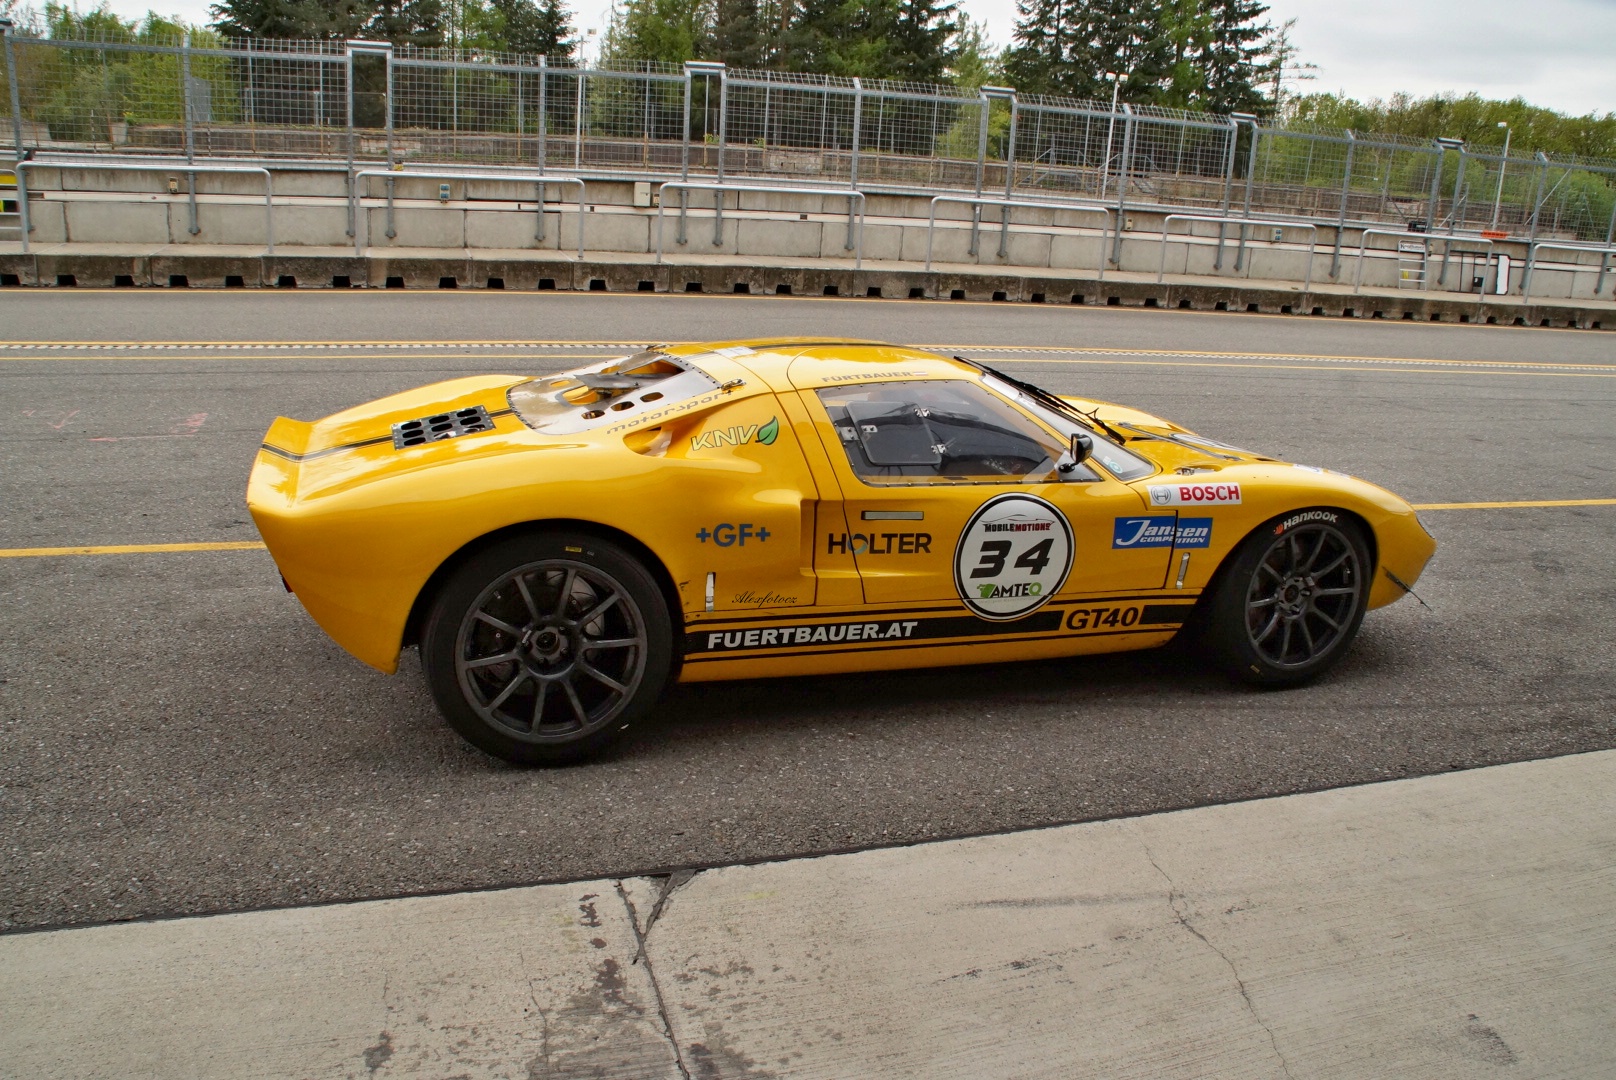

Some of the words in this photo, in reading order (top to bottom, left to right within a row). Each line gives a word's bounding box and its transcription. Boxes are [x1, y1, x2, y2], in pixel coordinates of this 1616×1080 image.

[690, 424, 758, 451] KNV
[1178, 485, 1240, 501] BOSCH
[827, 532, 932, 555] HOLTER
[1115, 519, 1209, 546] Jansen
[969, 538, 1055, 579] 34
[1066, 607, 1139, 630] GT40
[707, 621, 918, 649] FUERTBAUER.AT
